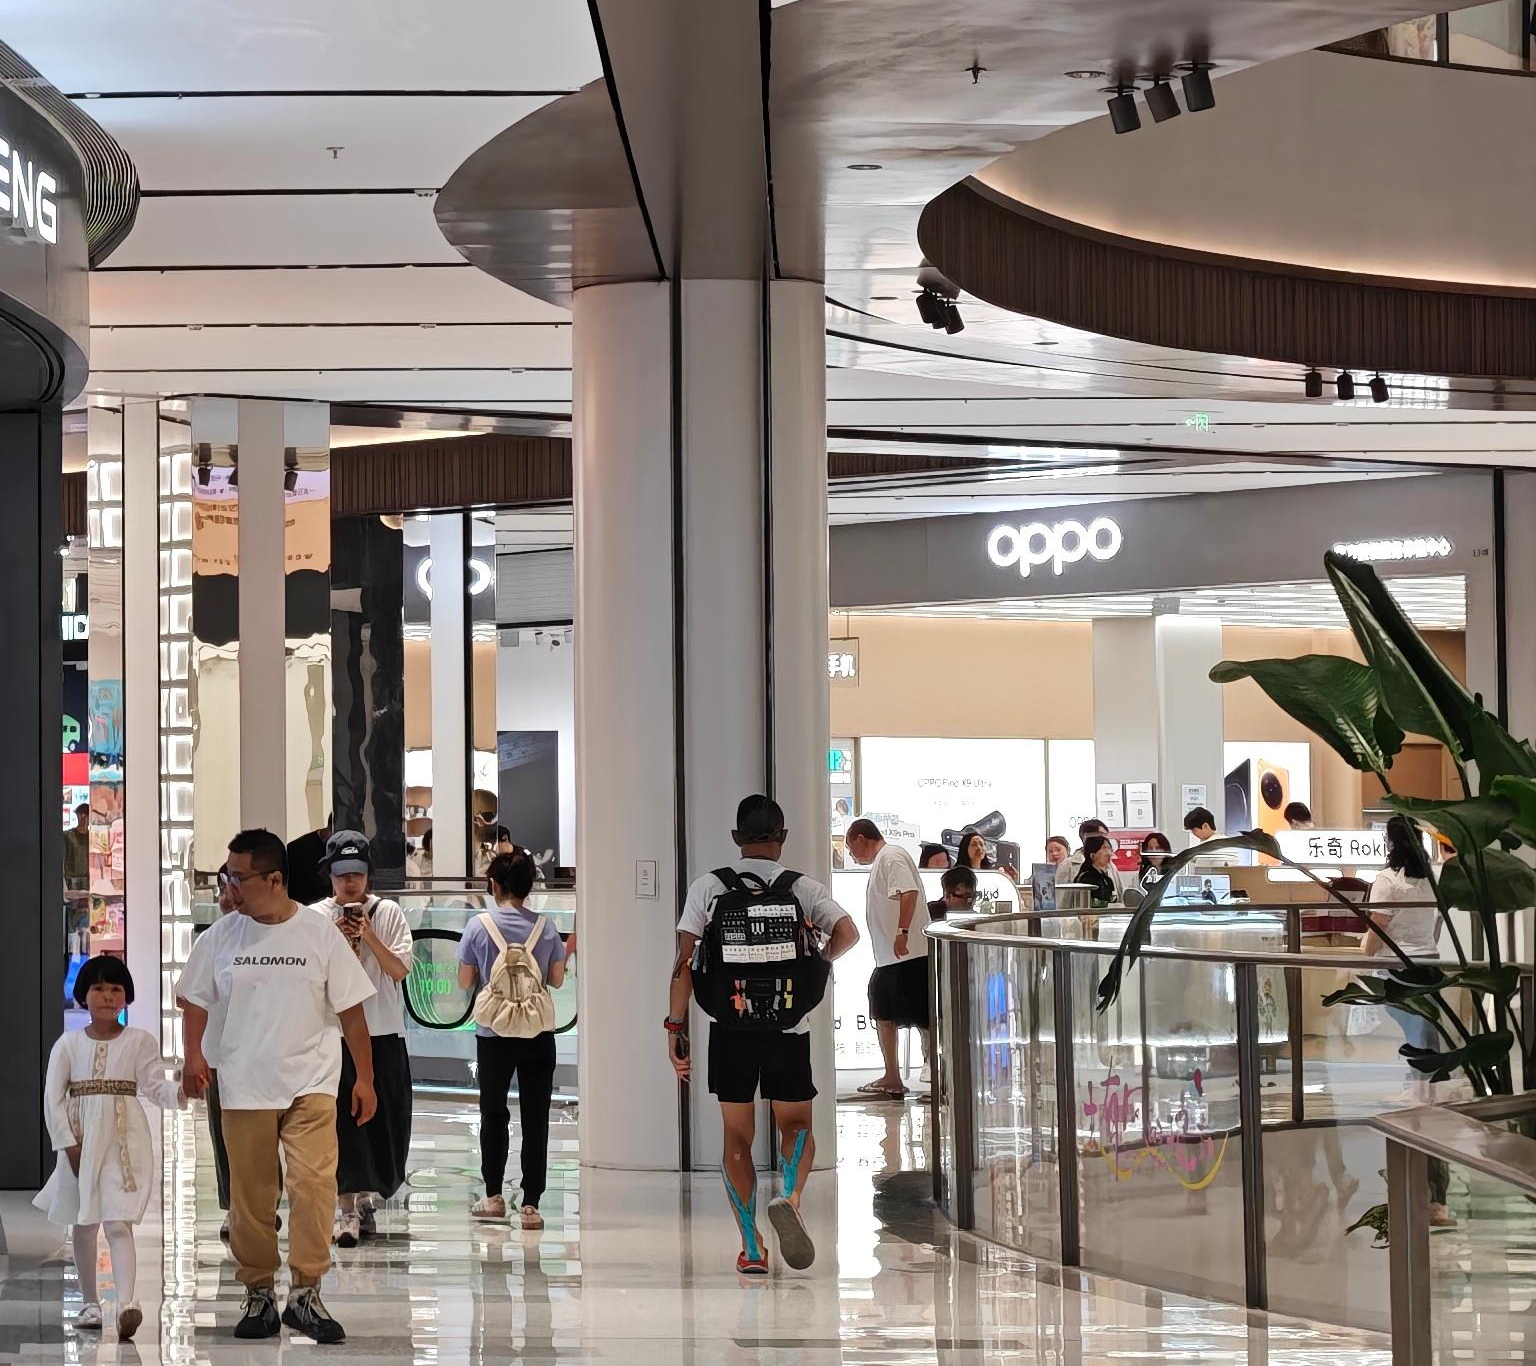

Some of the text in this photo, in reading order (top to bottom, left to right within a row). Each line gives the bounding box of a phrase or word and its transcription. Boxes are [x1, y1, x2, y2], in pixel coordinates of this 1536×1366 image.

[1308, 836, 1387, 859] 乐奇 Roki
[232, 955, 307, 967] SALOMON
